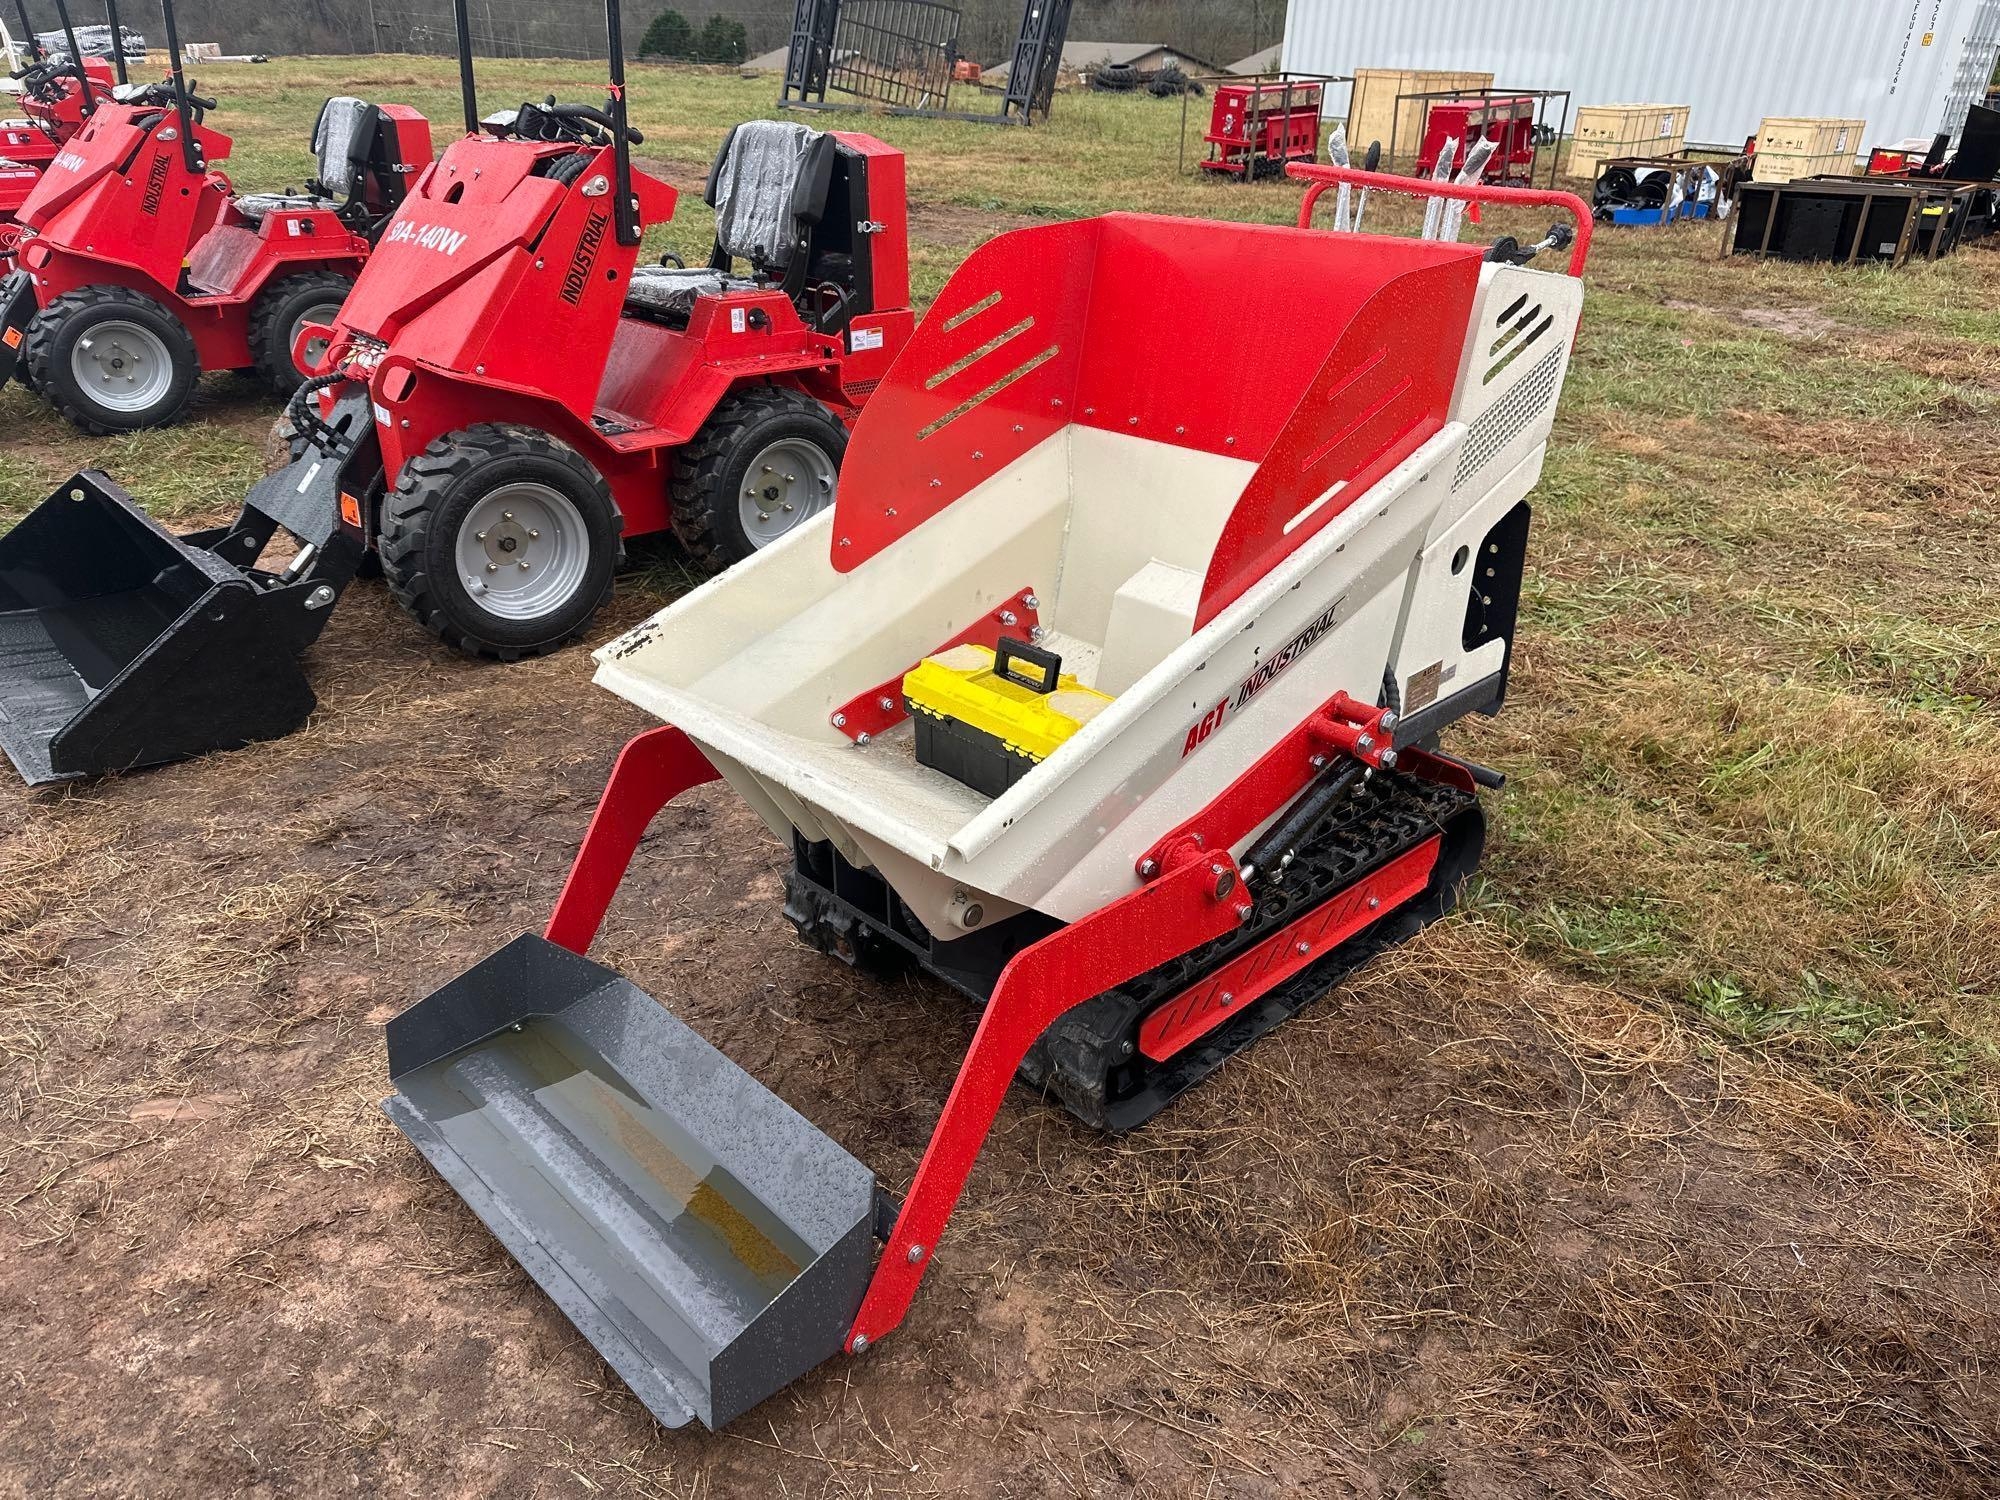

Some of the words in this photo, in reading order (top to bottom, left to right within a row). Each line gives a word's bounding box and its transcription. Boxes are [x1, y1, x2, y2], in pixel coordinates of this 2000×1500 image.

[143, 153, 170, 216] INDUSTRIAL
[560, 210, 609, 307] INDUSTRIAL
[1182, 696, 1230, 759] AGT
[1236, 605, 1337, 708] INDUSTRIAL
